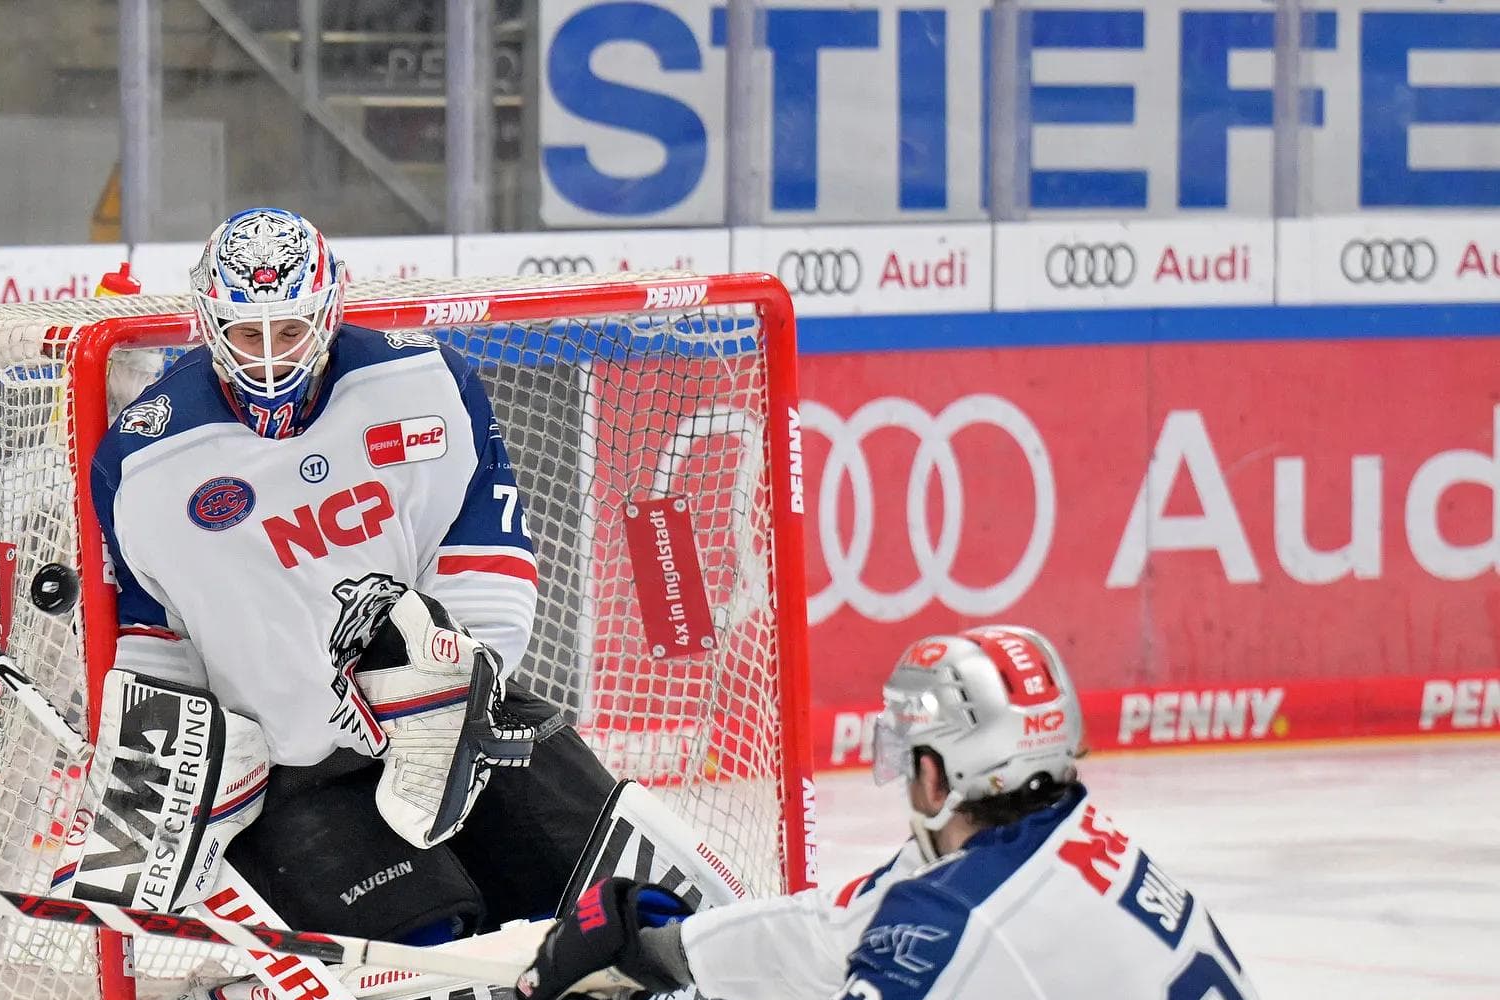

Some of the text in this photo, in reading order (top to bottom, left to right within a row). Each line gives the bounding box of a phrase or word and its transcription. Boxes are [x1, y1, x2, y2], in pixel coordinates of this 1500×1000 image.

[880, 249, 968, 289] Audi
[1154, 245, 1250, 283] Audi
[250, 402, 295, 440] 72
[261, 480, 395, 569] NCP
[649, 508, 690, 647] 4x in Ingolstadt
[1023, 710, 1065, 736] NCP
[140, 697, 208, 913] VERSICHERUNG
[339, 860, 414, 906] VAUGHN
[695, 841, 748, 900] WARRIOR
